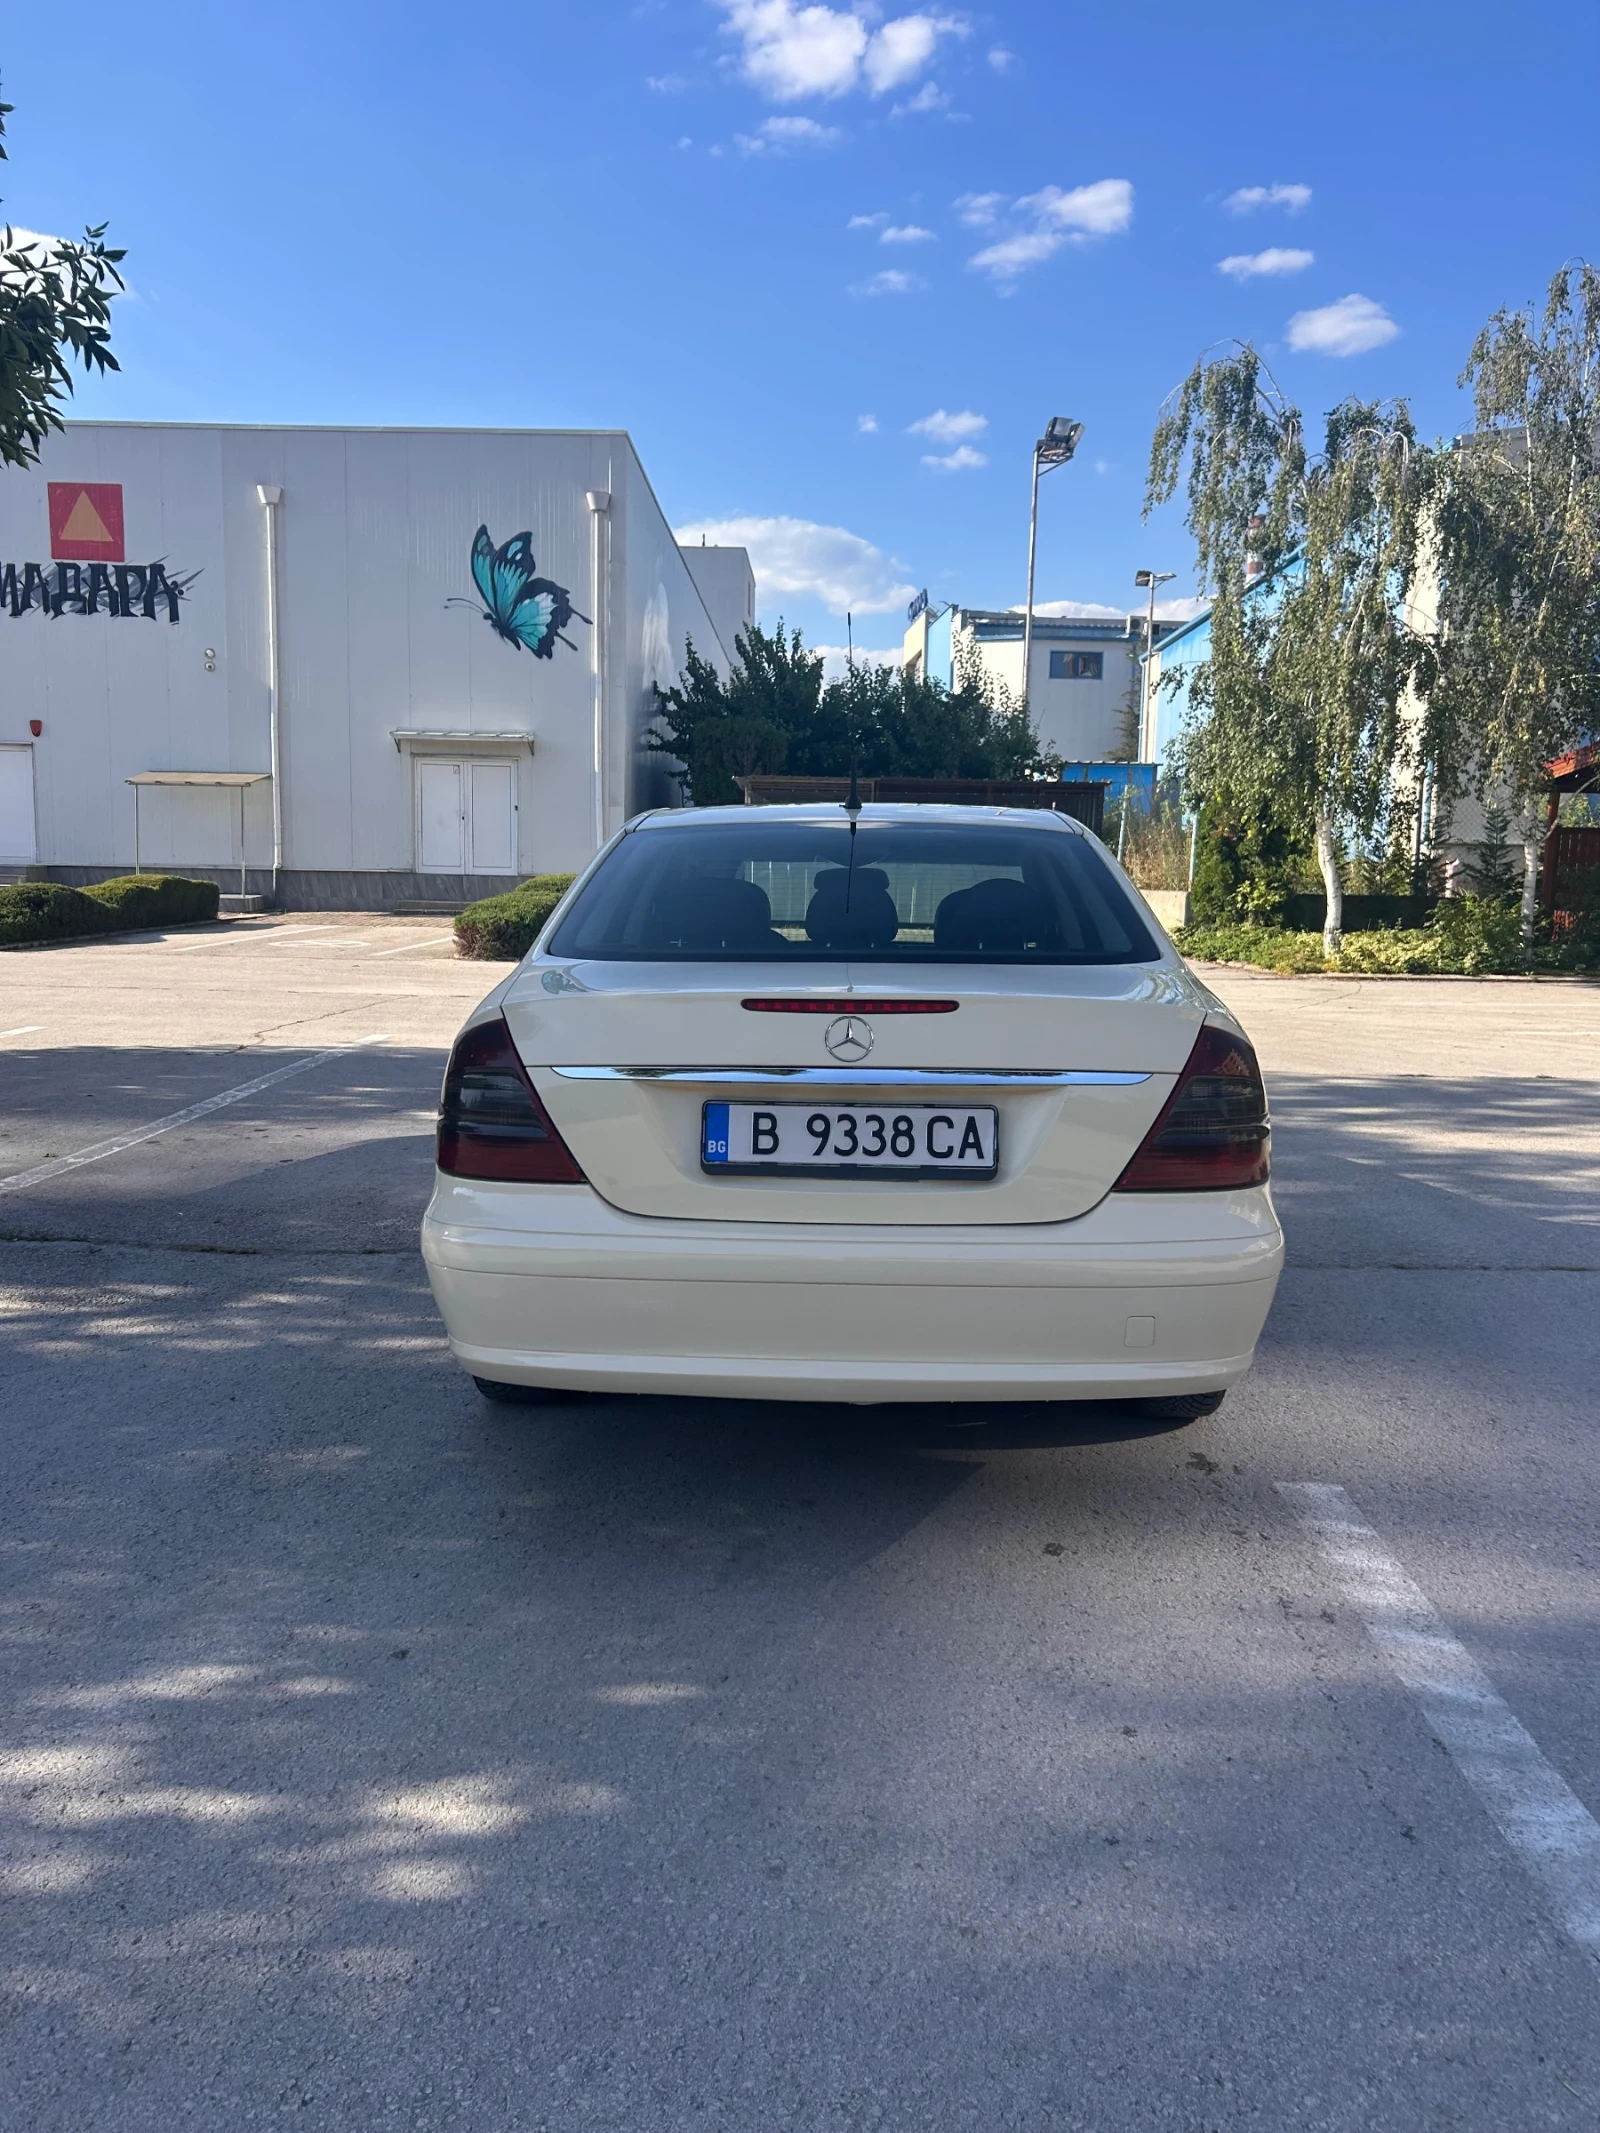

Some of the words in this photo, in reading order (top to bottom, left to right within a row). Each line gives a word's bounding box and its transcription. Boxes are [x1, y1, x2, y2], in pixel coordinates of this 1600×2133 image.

[707, 1140, 727, 1154] BG
[752, 1112, 780, 1155] B
[806, 1113, 916, 1158] 9338
